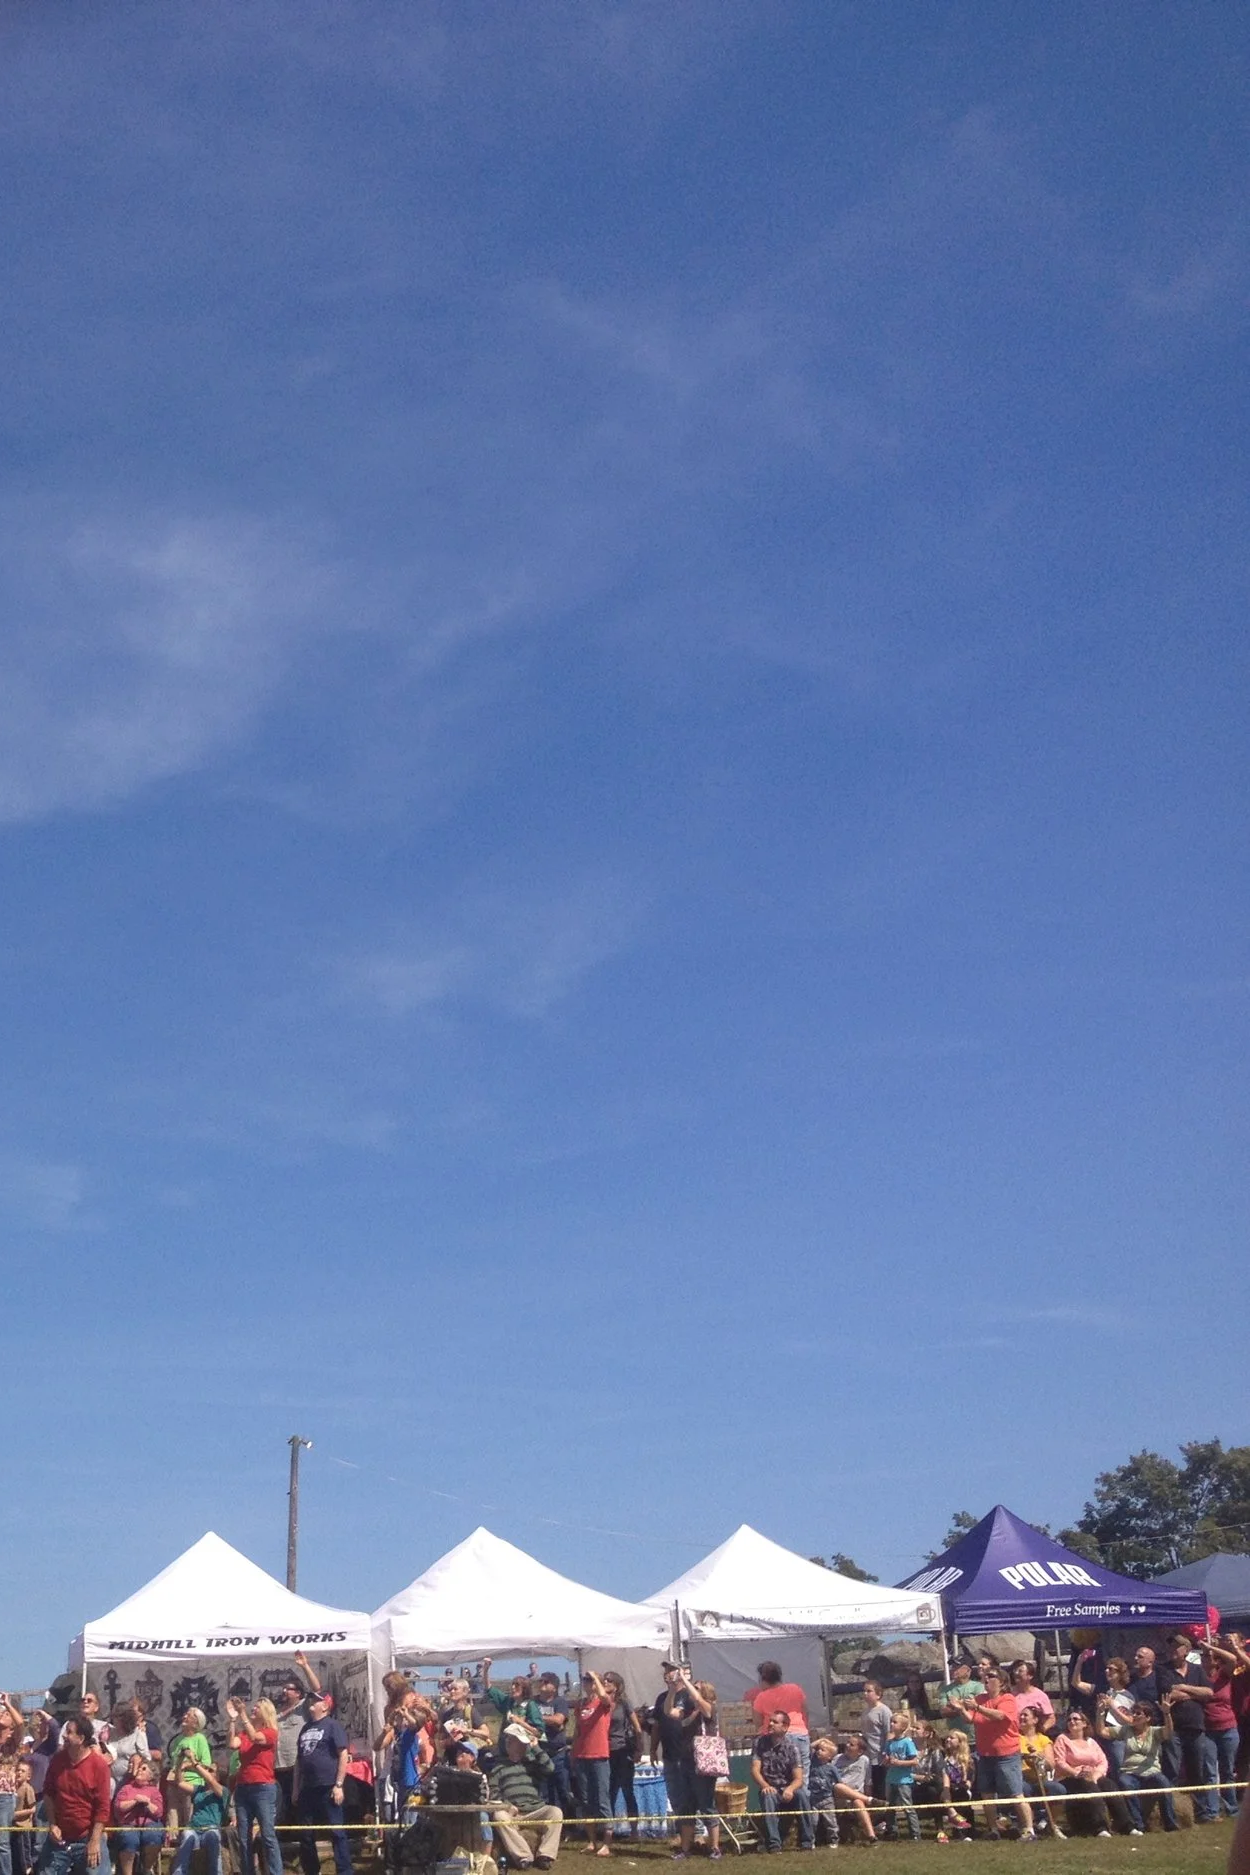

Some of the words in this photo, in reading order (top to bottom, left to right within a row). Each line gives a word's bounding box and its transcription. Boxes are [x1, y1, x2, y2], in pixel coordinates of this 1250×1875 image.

[998, 1561, 1102, 1591] POLAR
[1046, 1604, 1072, 1618] Free
[1074, 1602, 1121, 1619] Samples
[107, 1638, 197, 1651] MIDHILL
[205, 1636, 260, 1648] IRON
[267, 1631, 348, 1645] WORKS
